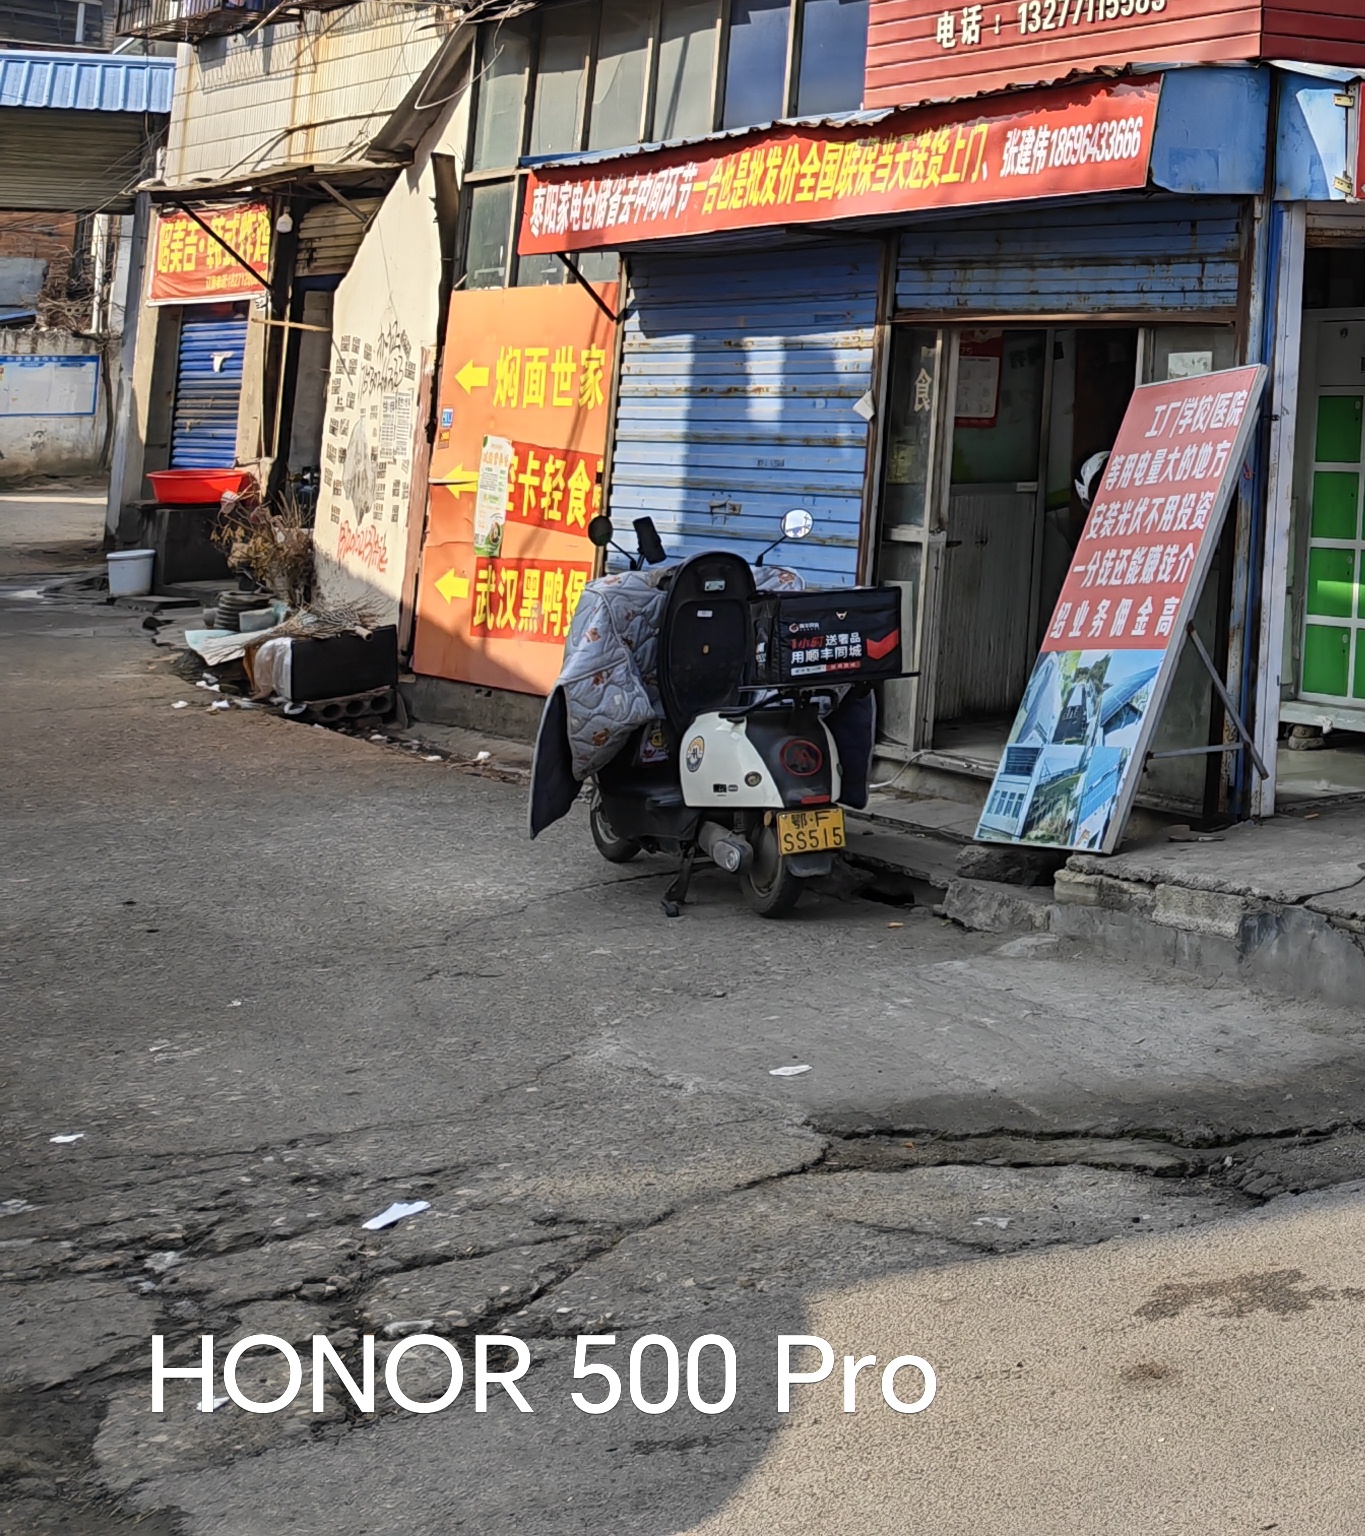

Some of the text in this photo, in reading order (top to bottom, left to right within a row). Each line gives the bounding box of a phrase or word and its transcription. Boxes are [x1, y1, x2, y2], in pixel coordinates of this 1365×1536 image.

[493, 343, 605, 409] 焖面世家
[1106, 440, 1232, 490] 等用电量大的地方
[1085, 491, 1211, 542] 安装光伏不用投资
[1073, 547, 1195, 590] 一分钱还能赚钱介
[791, 645, 862, 664] 用顺丰同城
[783, 827, 843, 852] SS515
